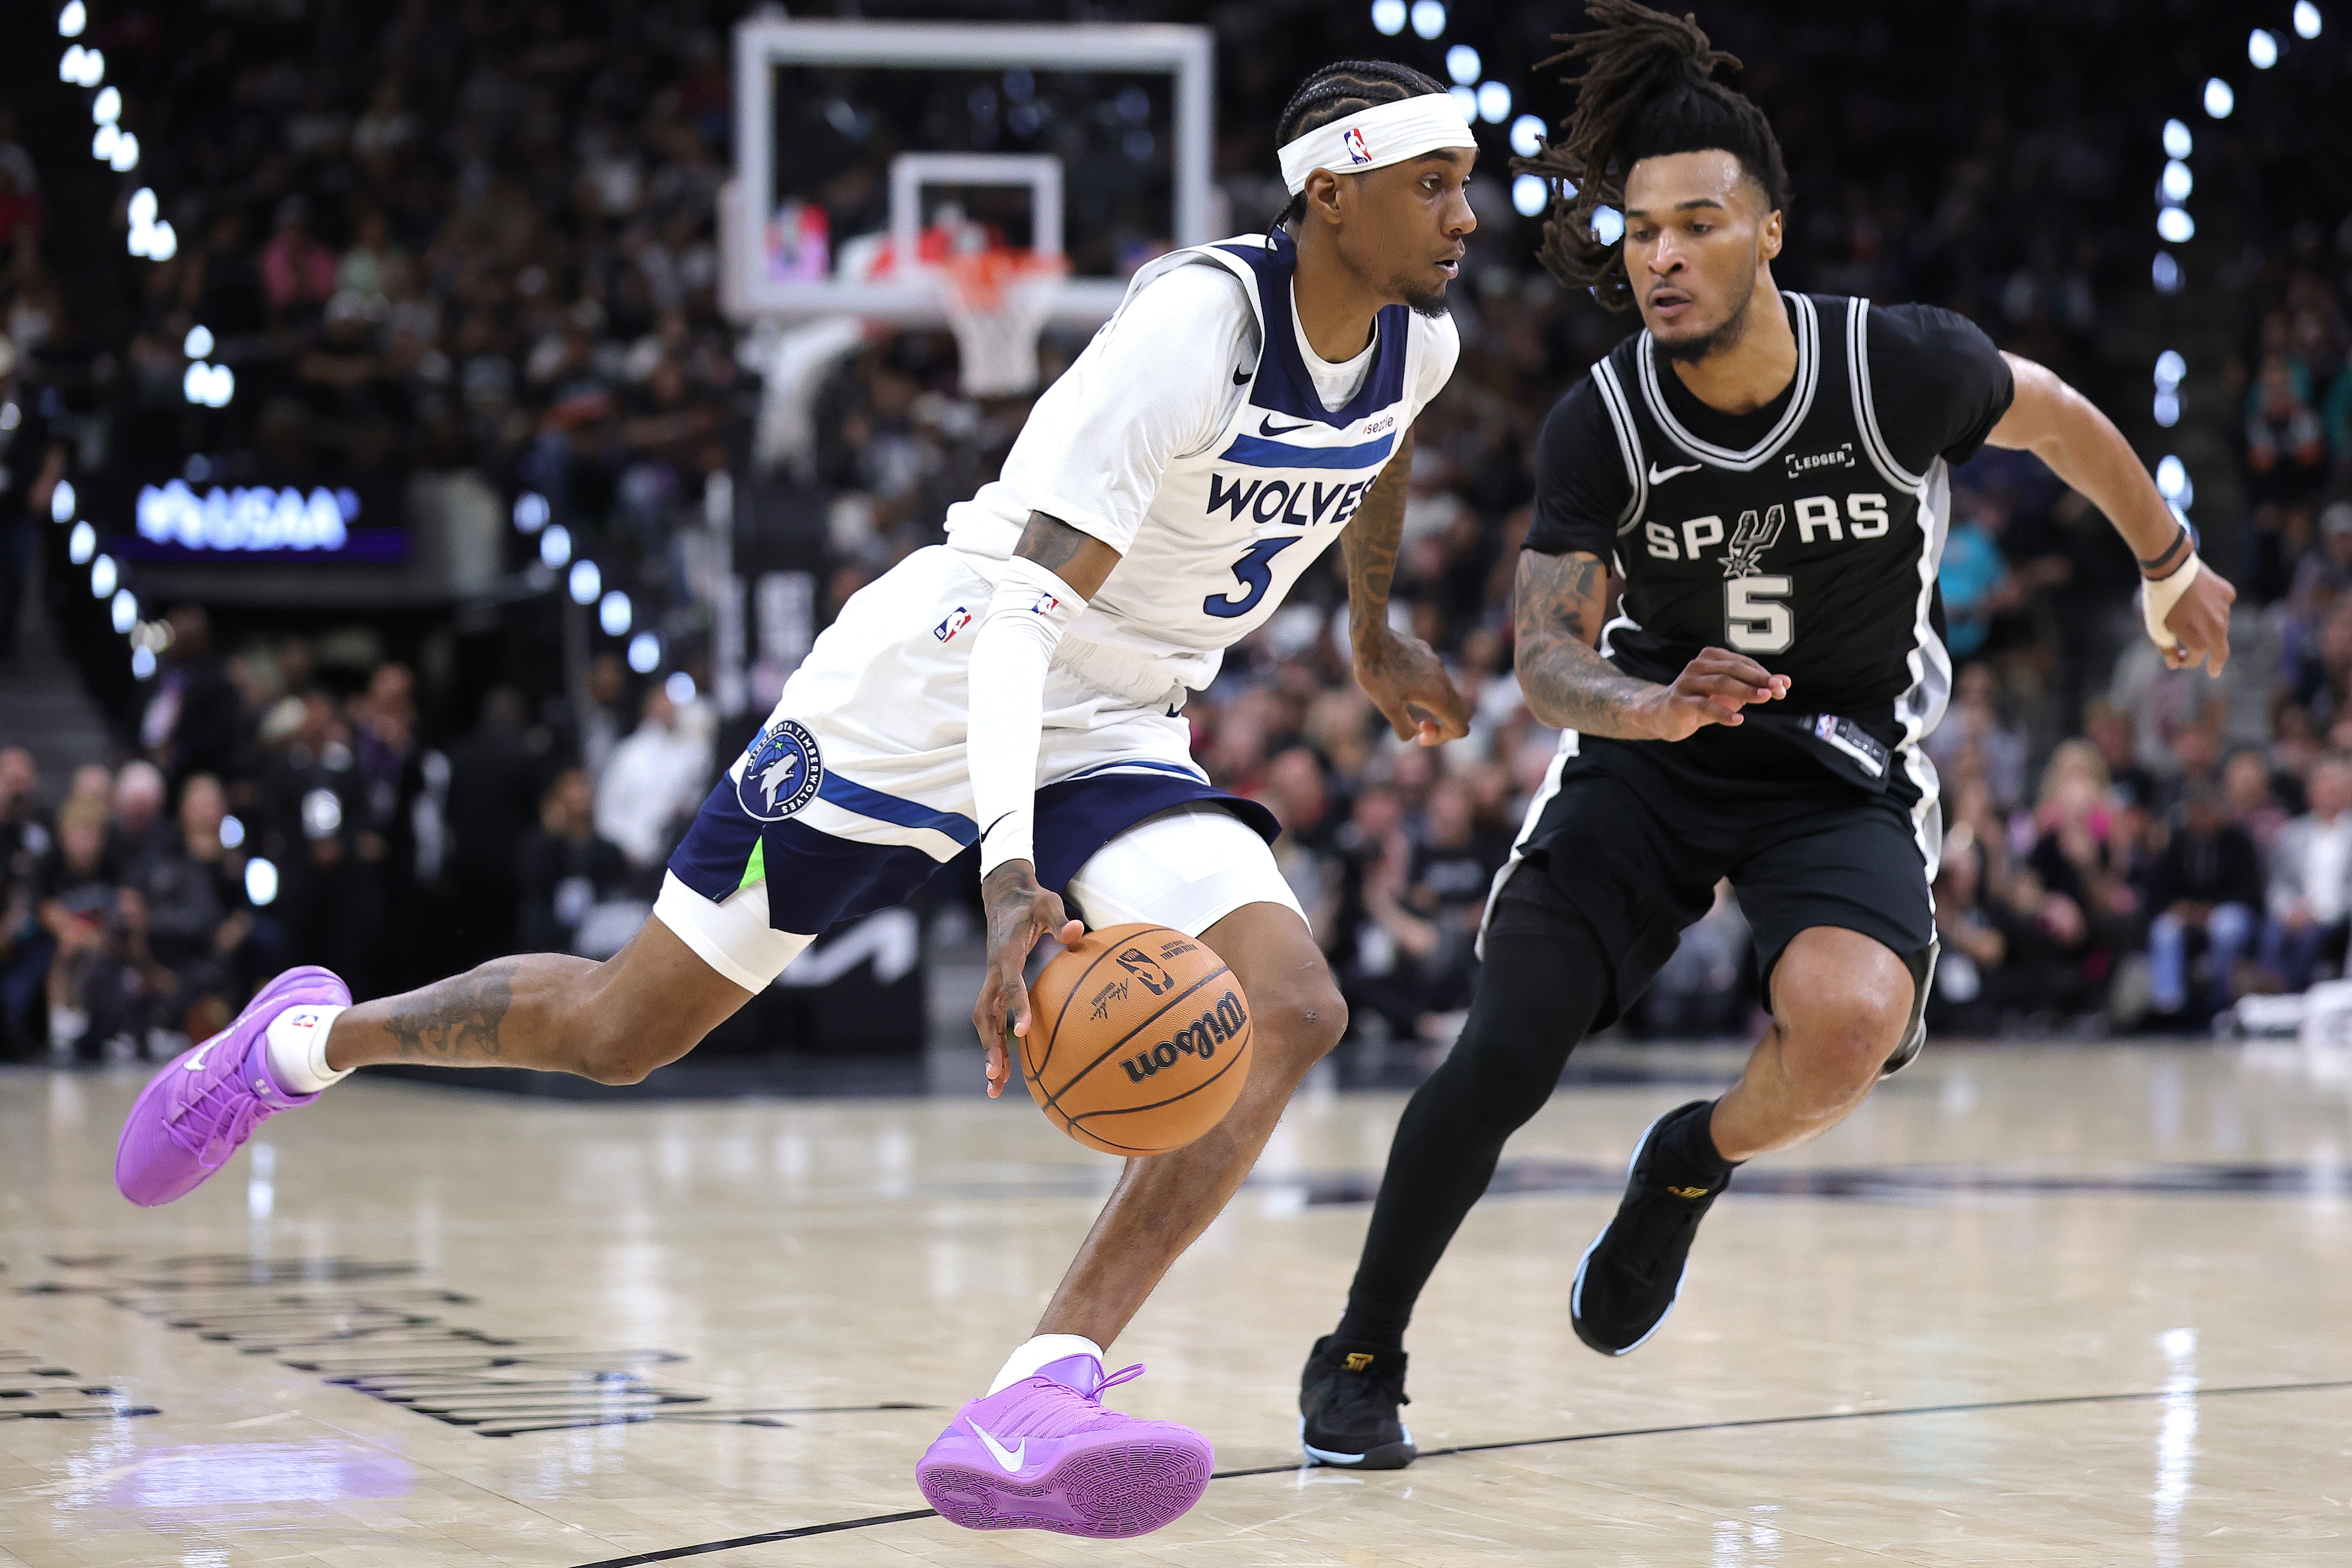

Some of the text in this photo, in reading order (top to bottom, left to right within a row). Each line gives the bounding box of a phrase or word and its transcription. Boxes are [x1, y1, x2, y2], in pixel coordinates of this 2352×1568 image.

[1367, 414, 1393, 434] sezzle
[1795, 451, 1845, 471] LEDGER
[1645, 492, 1890, 576] SPURS
[1203, 536, 1303, 618] 3
[1722, 575, 1795, 655] 5
[935, 626, 946, 639] NBA
[748, 722, 819, 814] MINNESOTA TIMBERWOLVES
[1123, 949, 1140, 961] NBA
[1119, 989, 1247, 1084] Wilson
